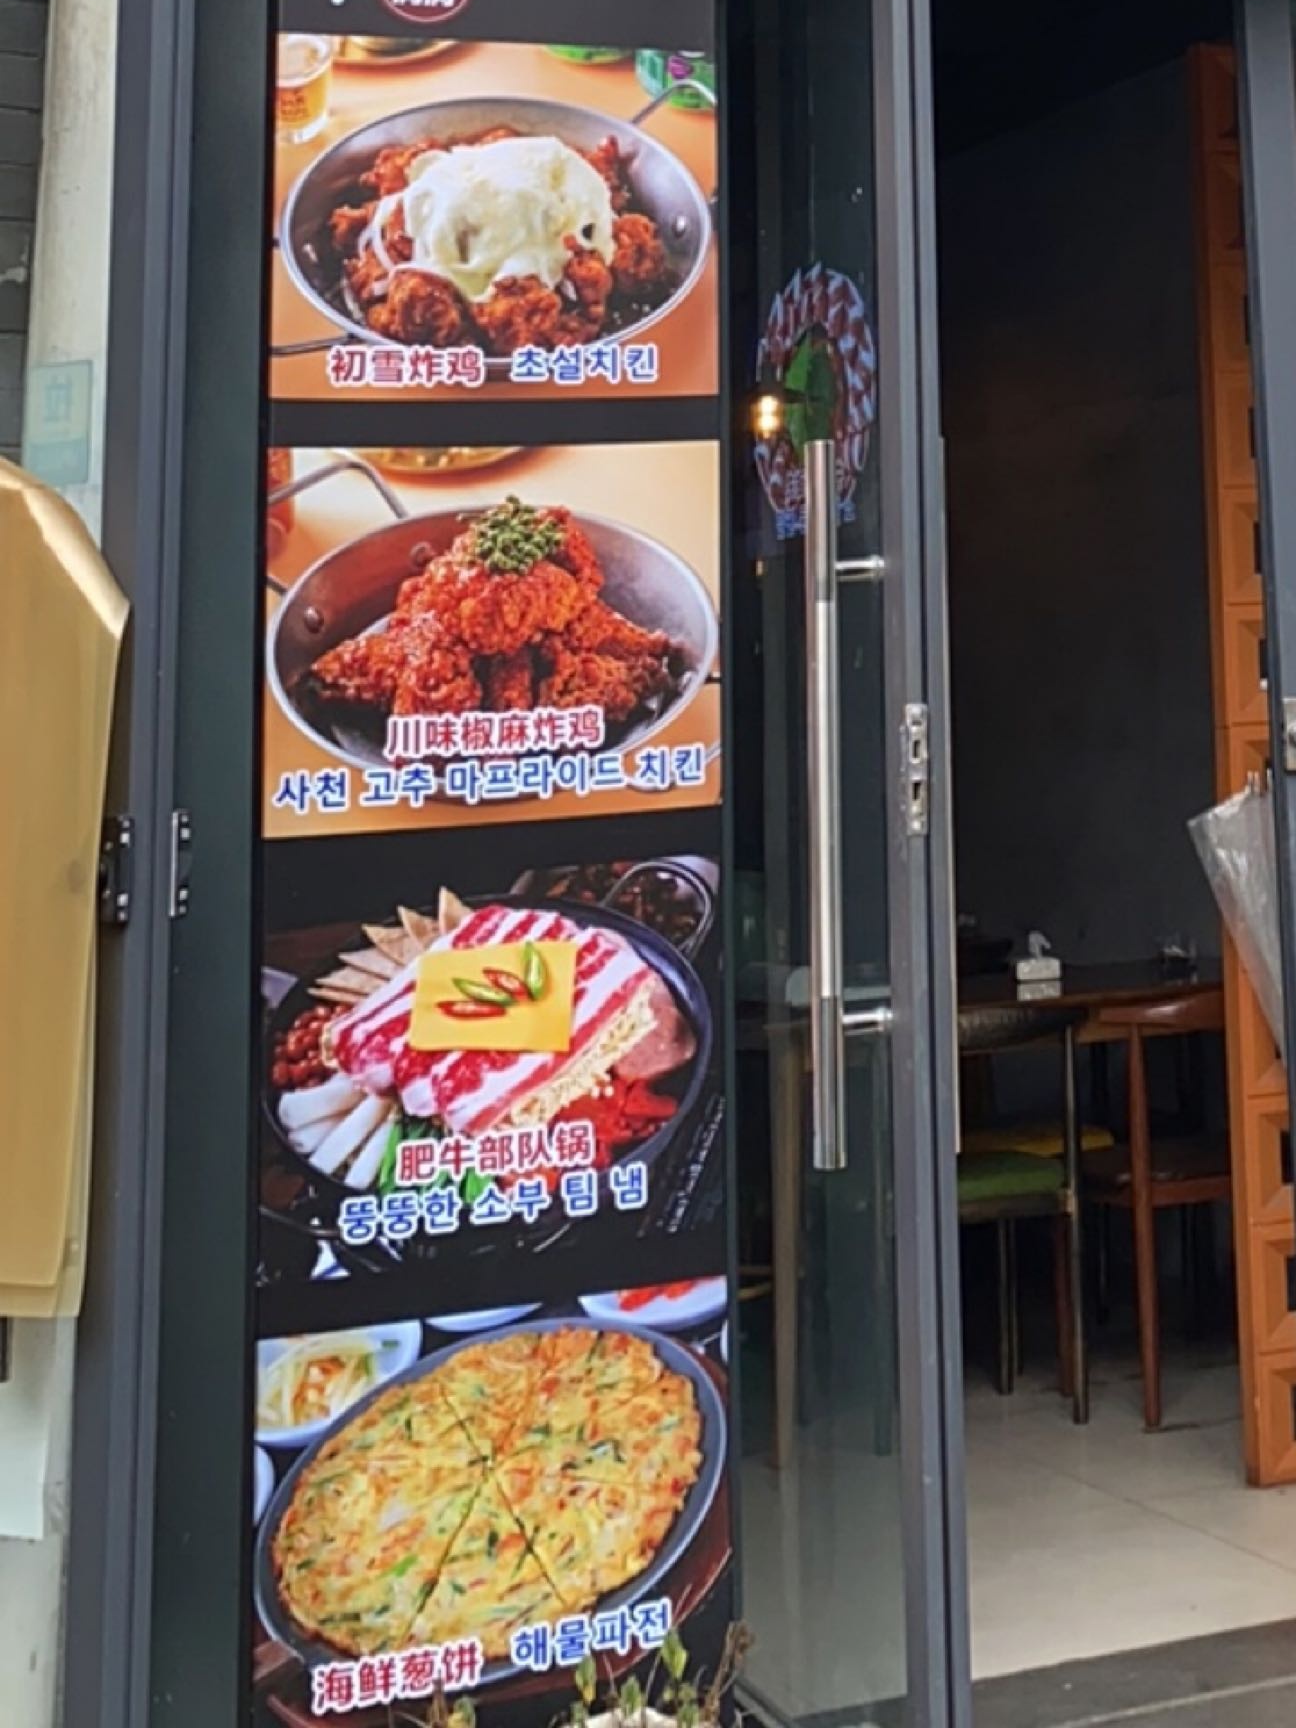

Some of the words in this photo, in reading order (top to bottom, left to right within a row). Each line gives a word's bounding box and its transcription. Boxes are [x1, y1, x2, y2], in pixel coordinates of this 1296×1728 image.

[330, 347, 484, 384] 初雪炸鸡
[512, 345, 658, 382] 초설치킨
[386, 710, 604, 756] 川味椒麻炸鸡
[275, 772, 348, 810] 사천
[361, 768, 433, 807] 고추
[447, 753, 625, 802] 마프라이드
[638, 748, 705, 788] 치킨
[399, 1124, 594, 1183] 肥牛部队锅
[340, 1190, 462, 1242] 뚱뚱한
[471, 1179, 552, 1223] 소부
[611, 1163, 647, 1208] 냄
[511, 1598, 672, 1669] 해물파전
[310, 1640, 483, 1714] 海鲜葱饼
